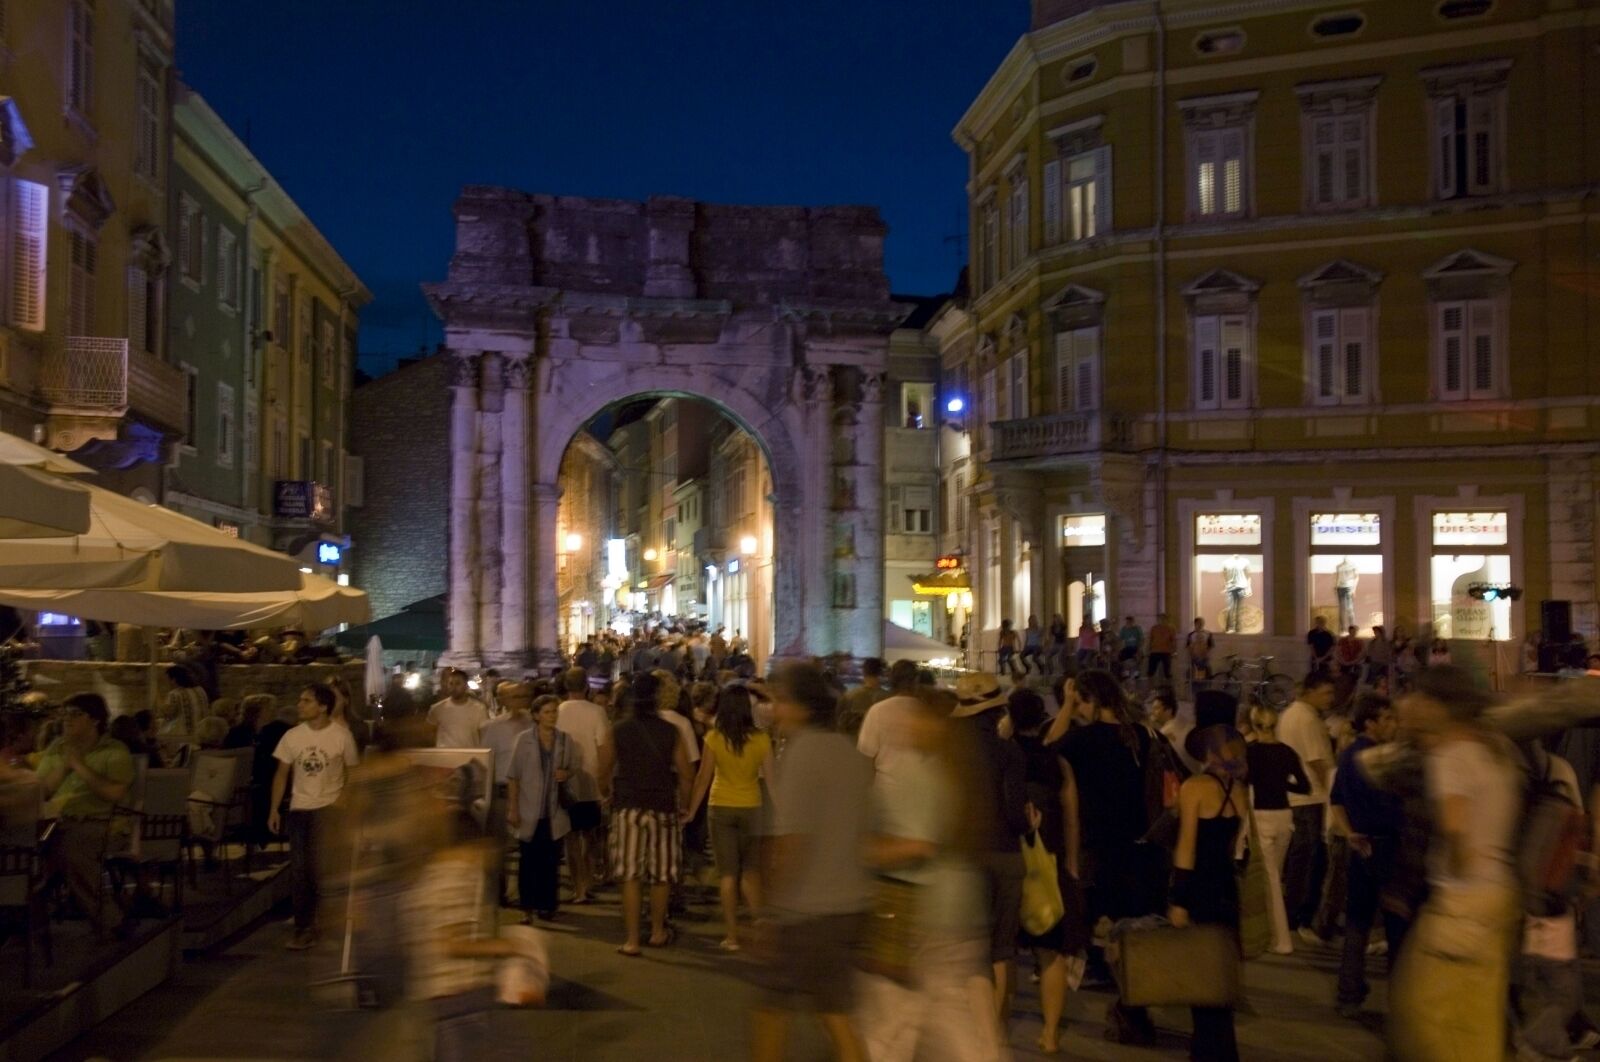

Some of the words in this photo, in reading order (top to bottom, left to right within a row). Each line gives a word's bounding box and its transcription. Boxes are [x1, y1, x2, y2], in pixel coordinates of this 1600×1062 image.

[1202, 527, 1257, 535] DIESEL
[1317, 526, 1377, 534] DIESEL
[1439, 525, 1503, 534] DIESEL
